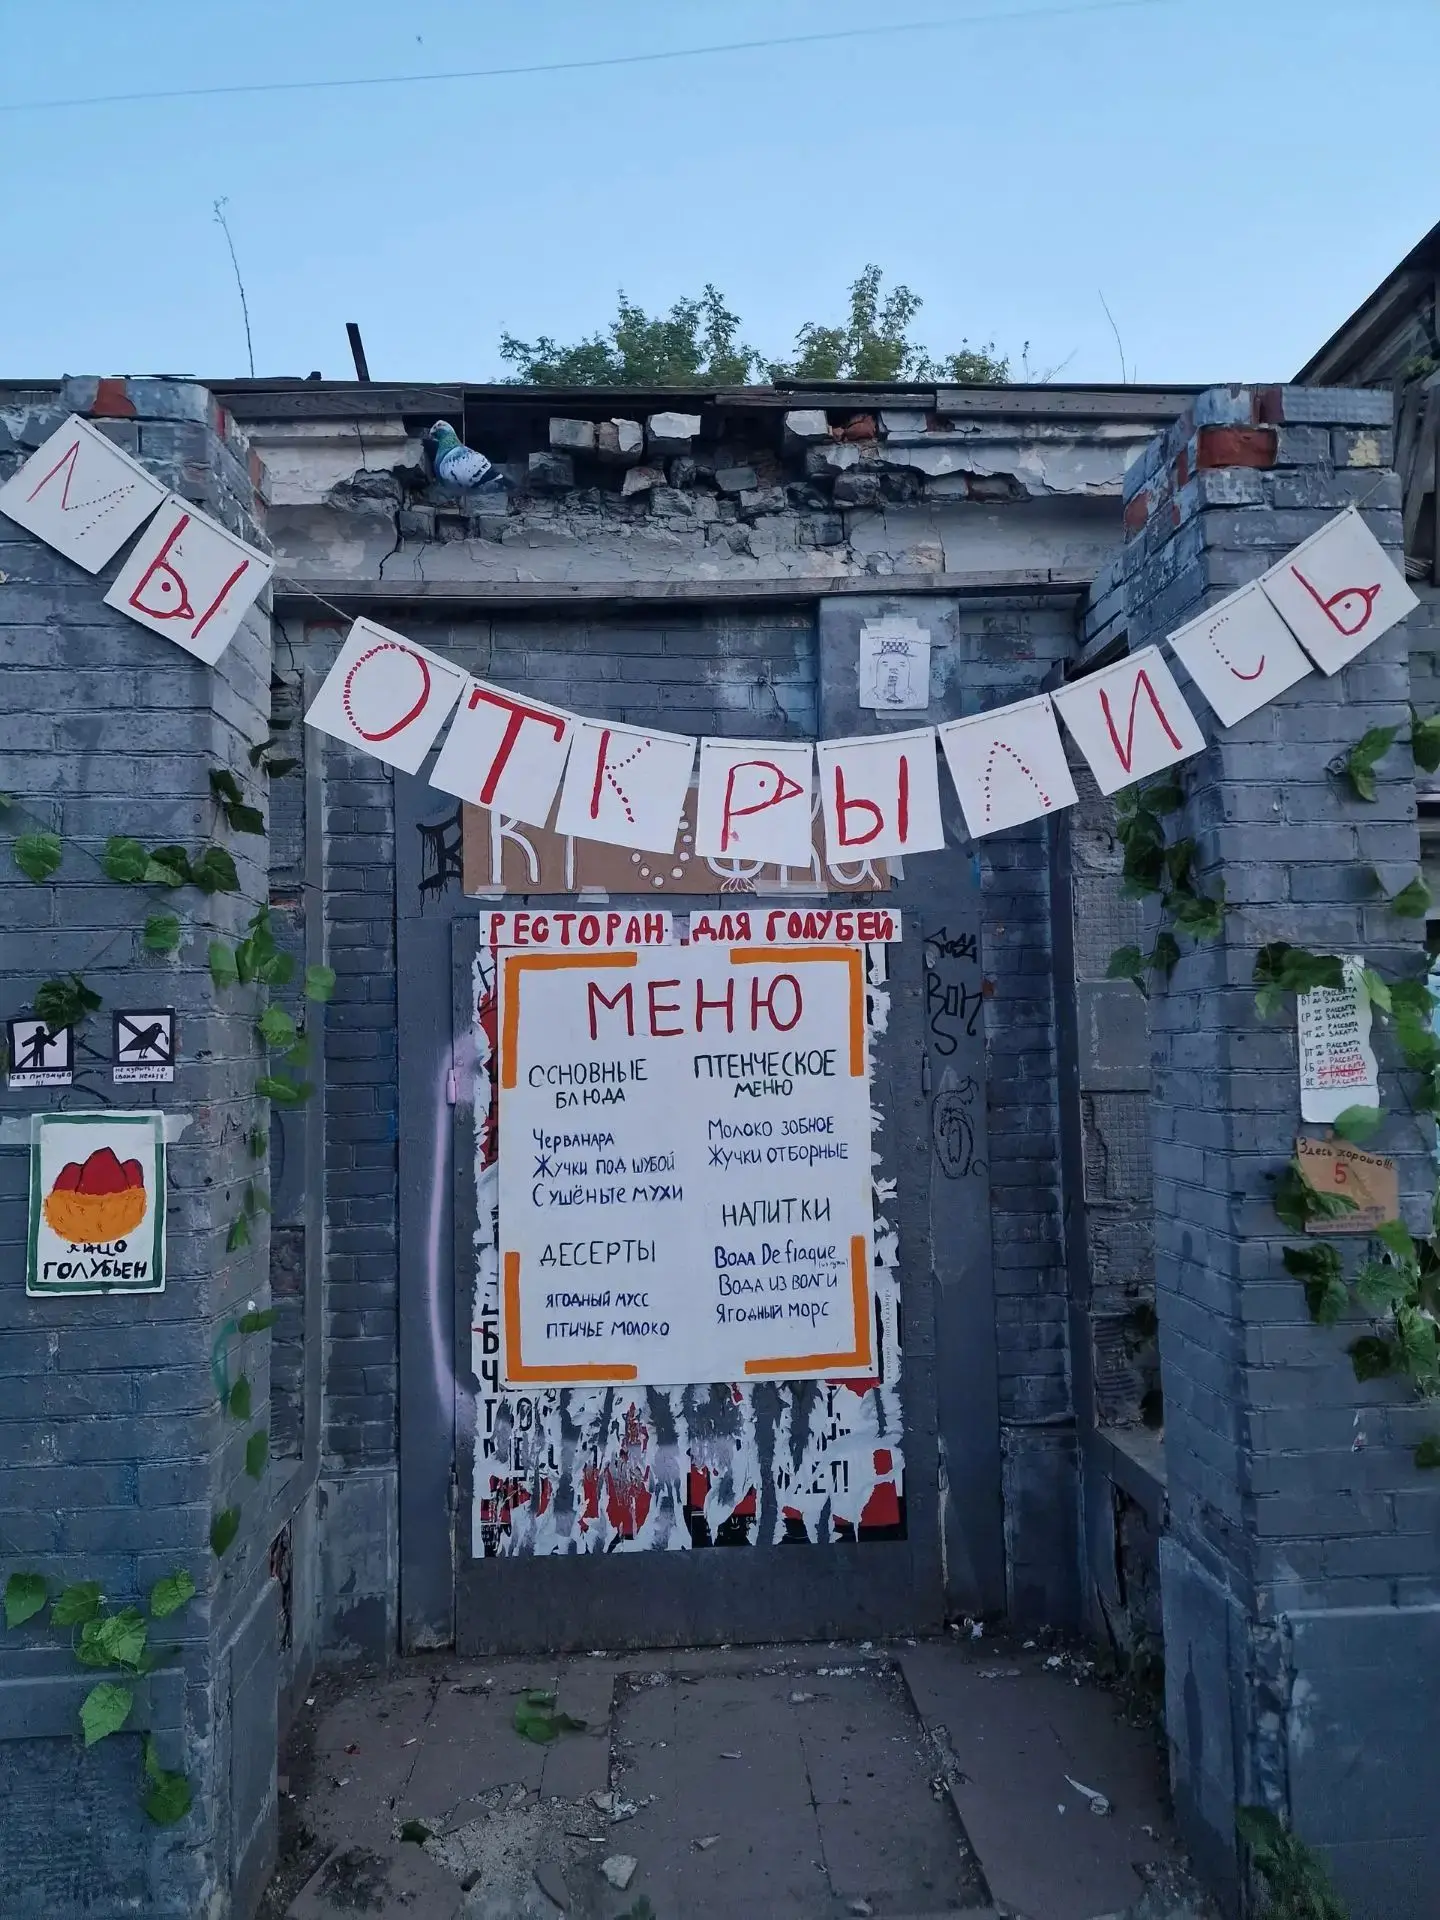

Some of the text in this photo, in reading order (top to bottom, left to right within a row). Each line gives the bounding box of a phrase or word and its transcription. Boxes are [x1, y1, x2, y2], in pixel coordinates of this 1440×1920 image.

[26, 440, 1381, 853] МЫ ОТКРЫЛИСЬ
[489, 910, 894, 946] РЕСТОРАН ДЛЯ ГОЛУБЕЙ
[587, 974, 802, 1040] МЕНЮ
[11, 1073, 26, 1081] БЕЗ
[528, 1058, 649, 1088] ОСНОВНЫЕ
[694, 1049, 837, 1079] ПТЕНЧЕСКОЕ
[555, 1087, 626, 1109] БЛЮДА
[734, 1078, 793, 1098] МЕНЮ
[532, 1153, 588, 1179] Жучки
[708, 1143, 762, 1172] Жучки
[1334, 1161, 1349, 1185] 5
[722, 1196, 830, 1228] НАПИТКИ
[540, 1239, 656, 1267] ДЕСЕРТЫ
